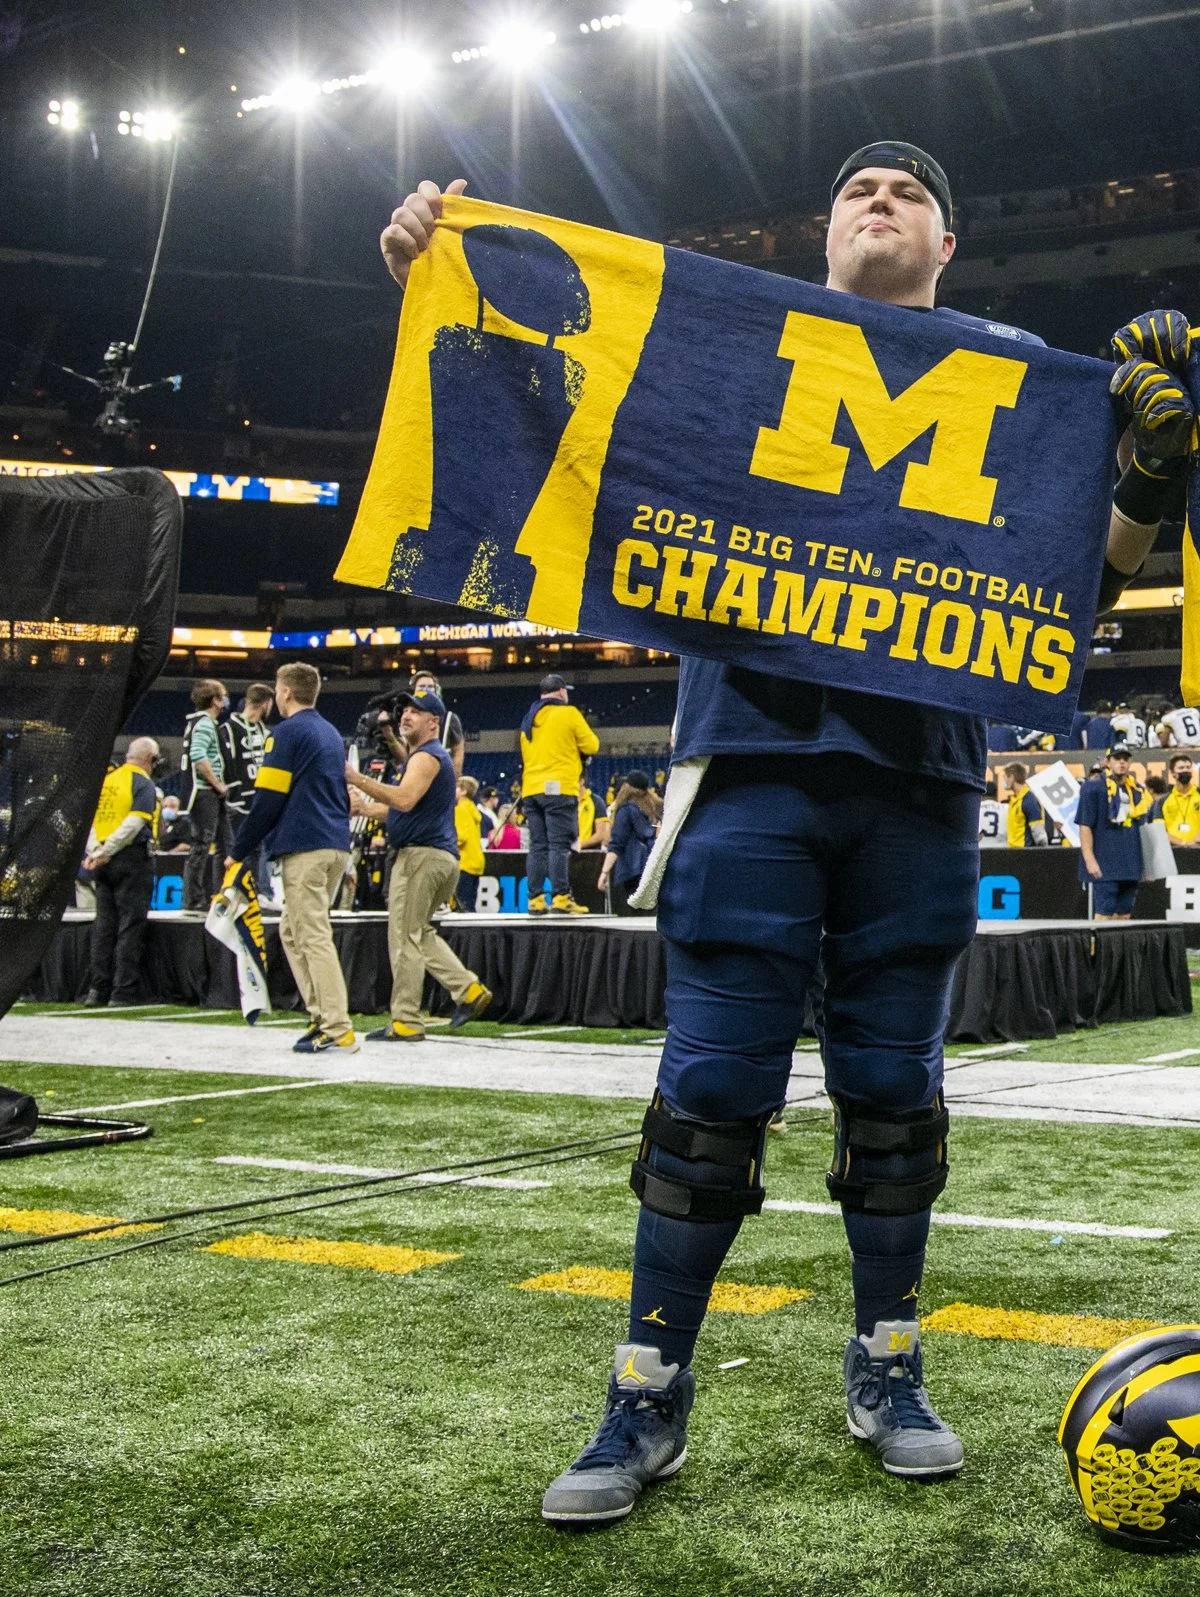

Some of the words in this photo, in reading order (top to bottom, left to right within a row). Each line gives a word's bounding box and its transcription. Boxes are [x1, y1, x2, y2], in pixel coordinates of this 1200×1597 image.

[633, 503, 716, 546] 2021
[728, 524, 793, 563] BIG
[892, 557, 1070, 620] FOOTBALL
[611, 538, 1077, 695] CHAMPIONS
[419, 623, 488, 642] MICHIGAN
[1181, 715, 1197, 737] 6
[888, 1331, 912, 1352] M
